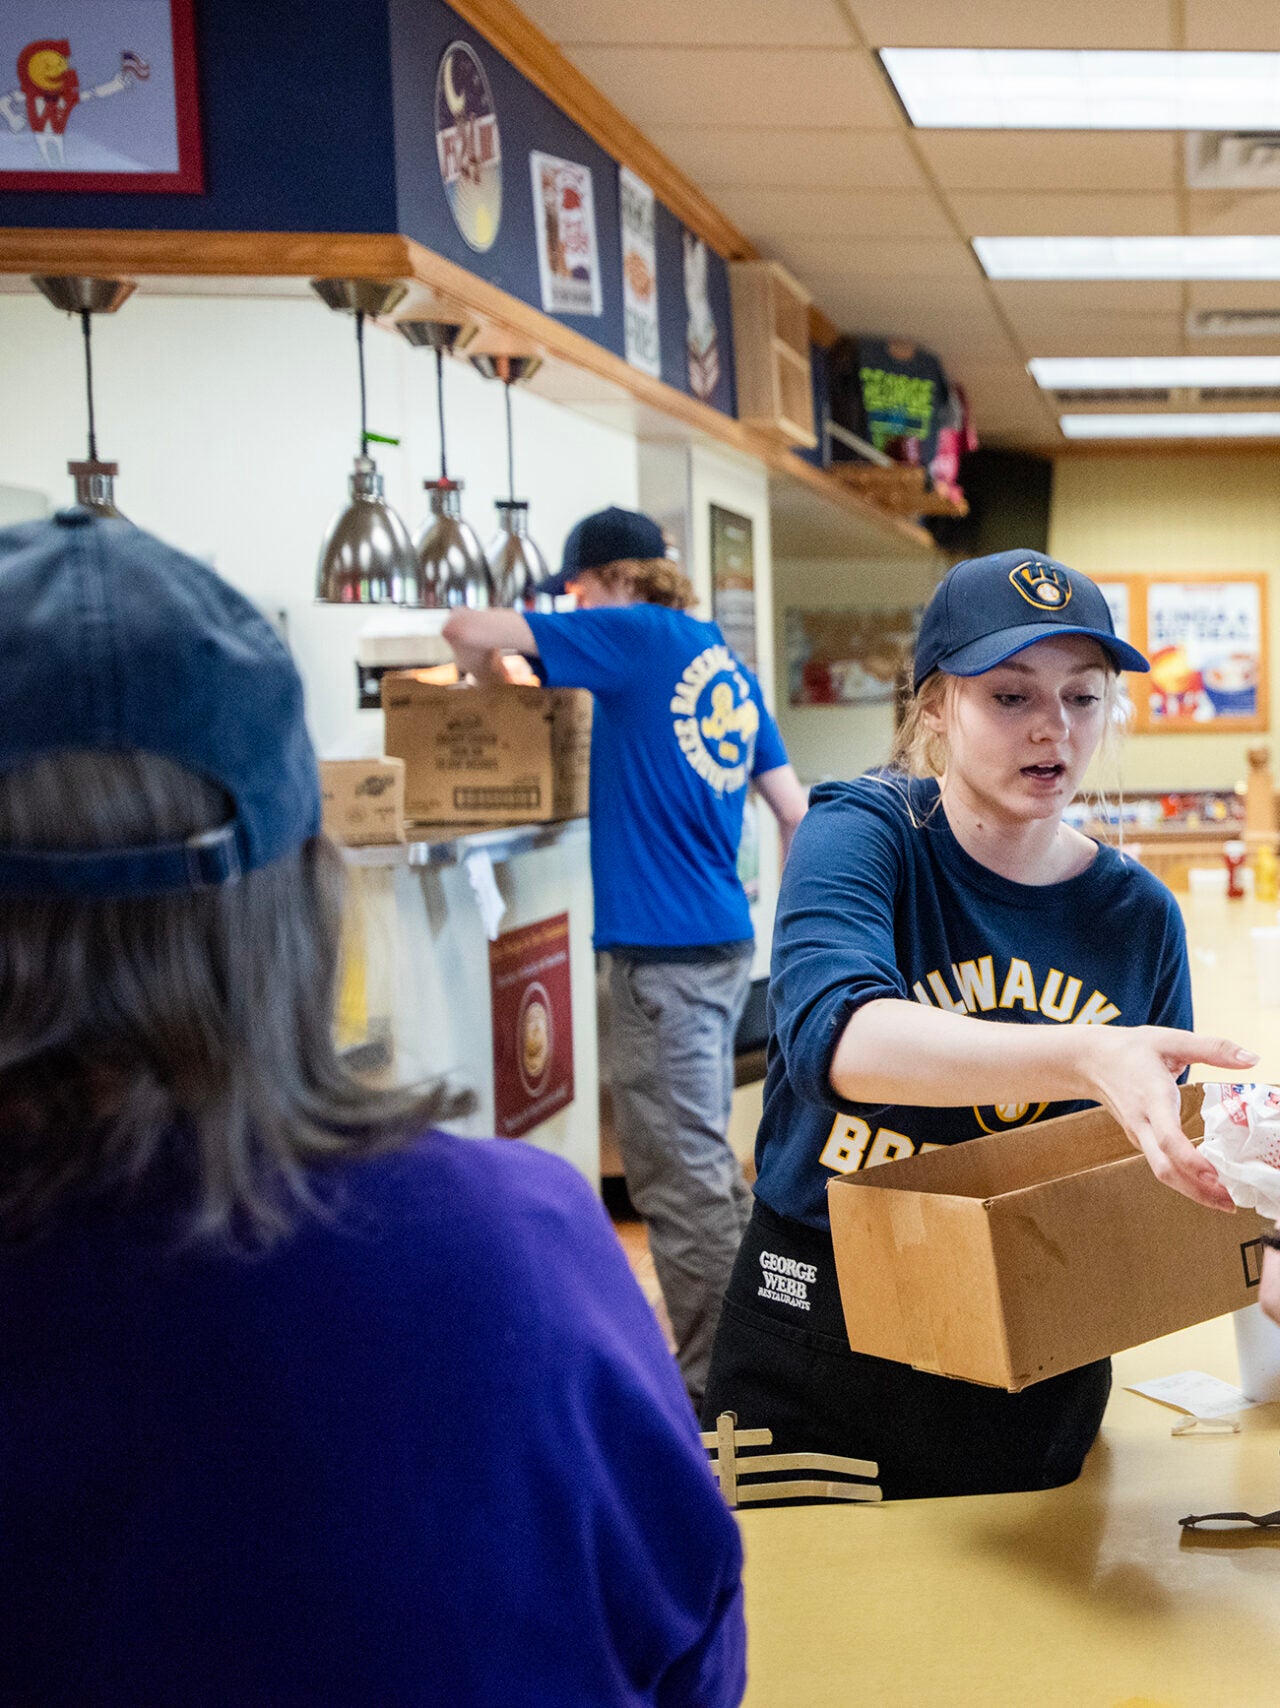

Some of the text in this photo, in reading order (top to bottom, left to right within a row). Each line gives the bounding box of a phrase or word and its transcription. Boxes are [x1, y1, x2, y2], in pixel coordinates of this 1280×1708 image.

[759, 1250, 818, 1284] GEORGE
[757, 1286, 811, 1311] RESTAURANTS
[762, 1270, 807, 1300] WEBB
